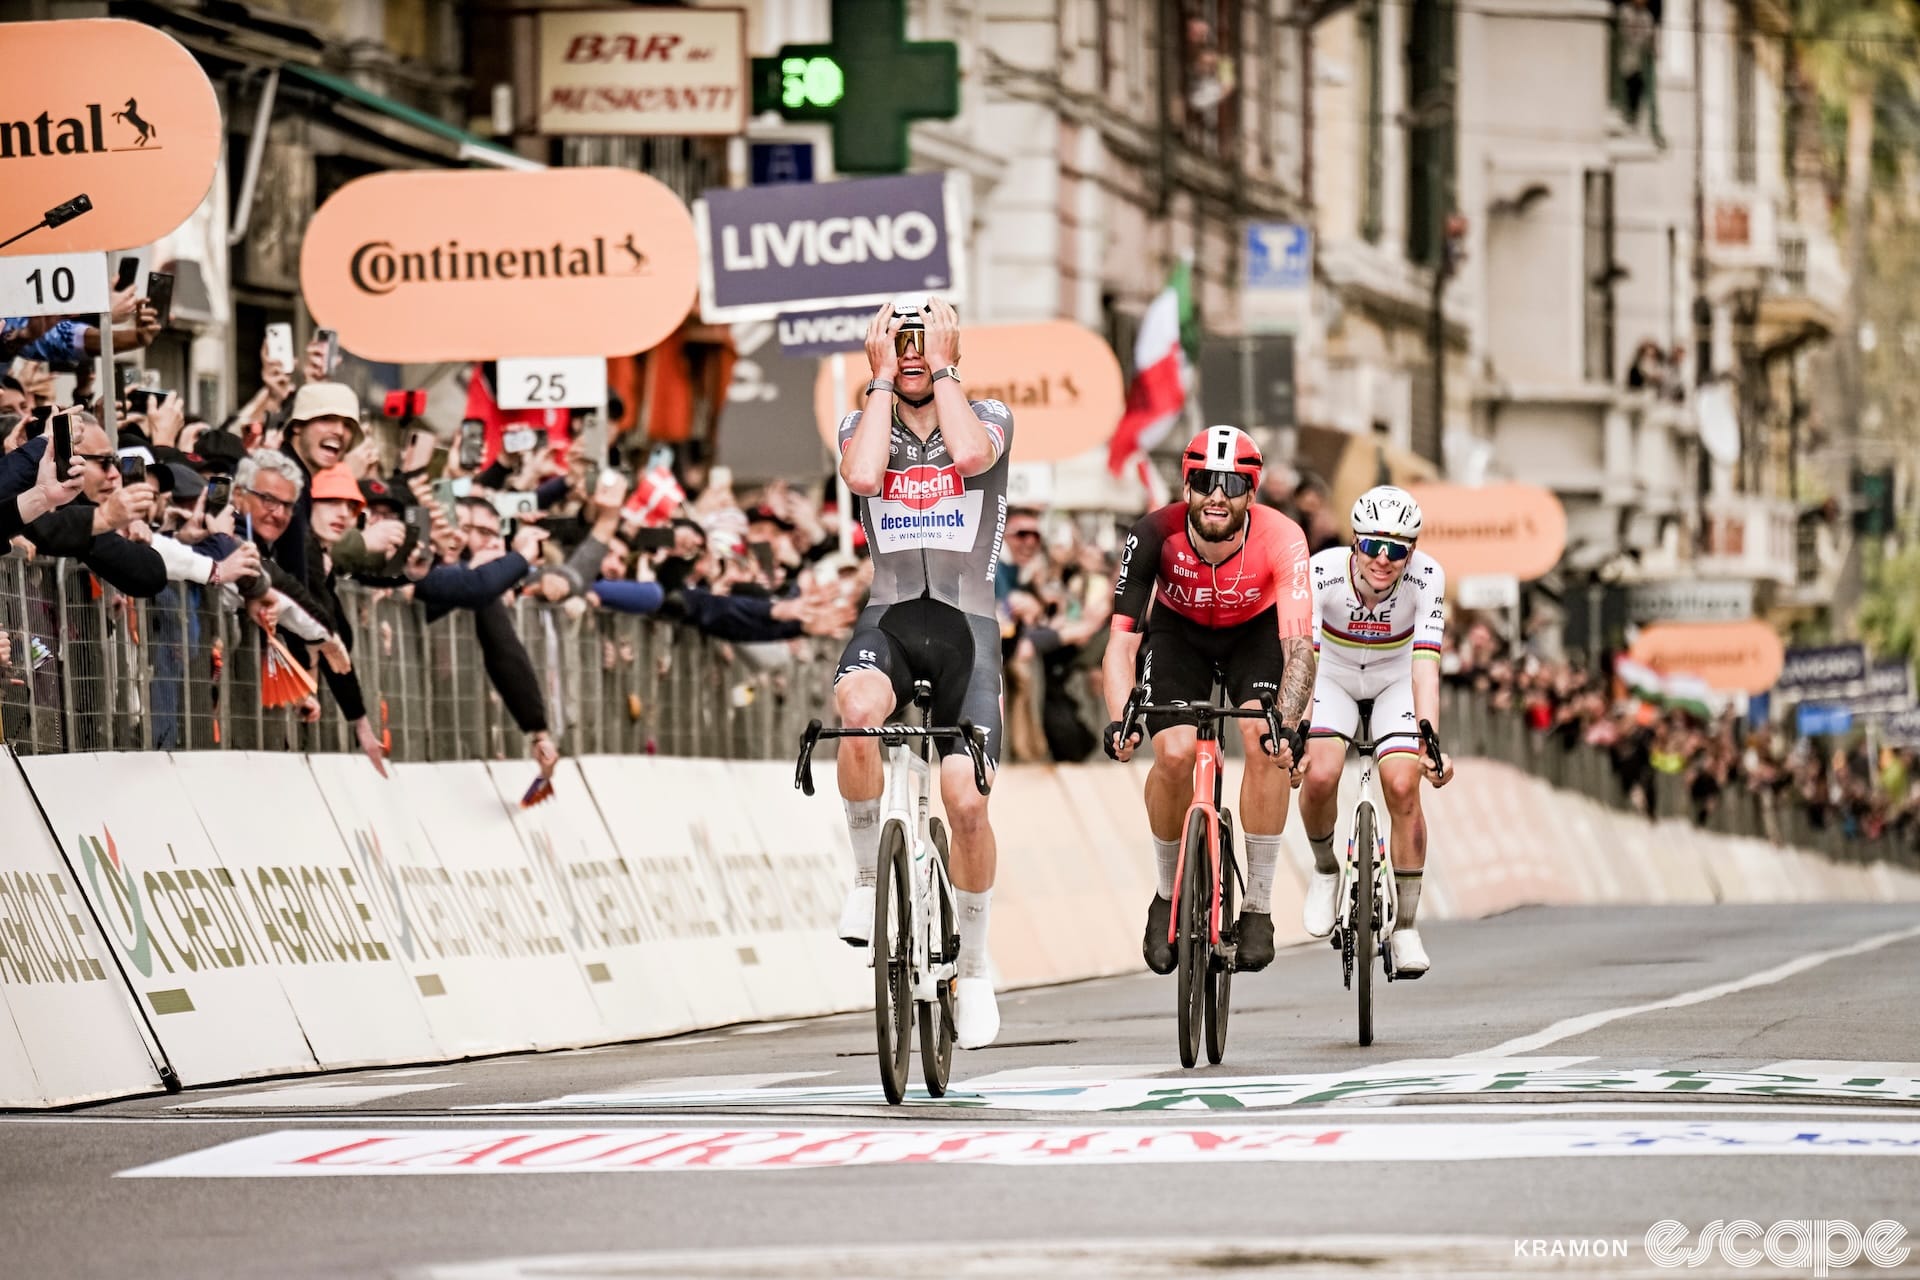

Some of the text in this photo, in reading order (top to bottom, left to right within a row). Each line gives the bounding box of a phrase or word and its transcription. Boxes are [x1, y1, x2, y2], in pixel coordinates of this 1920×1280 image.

[564, 33, 682, 63] BAR
[722, 211, 938, 271] LIVIGNO
[351, 237, 606, 296] Continental
[26, 266, 75, 304] 10
[524, 374, 567, 402] 25
[889, 472, 955, 499] Alpecin
[913, 489, 955, 500] BOOSTER
[881, 509, 965, 531] deceuninck
[899, 531, 942, 540] WINDOWS
[985, 494, 1008, 583] deceuninck
[1114, 532, 1139, 596] INEOS
[1173, 563, 1199, 580] GOBIK
[1290, 540, 1309, 601] INEOS
[1165, 582, 1261, 604] INEOS
[1350, 610, 1391, 622] UAE
[1252, 681, 1278, 690] GOBIK
[143, 843, 391, 973] CRÉDIT AGRICOLE
